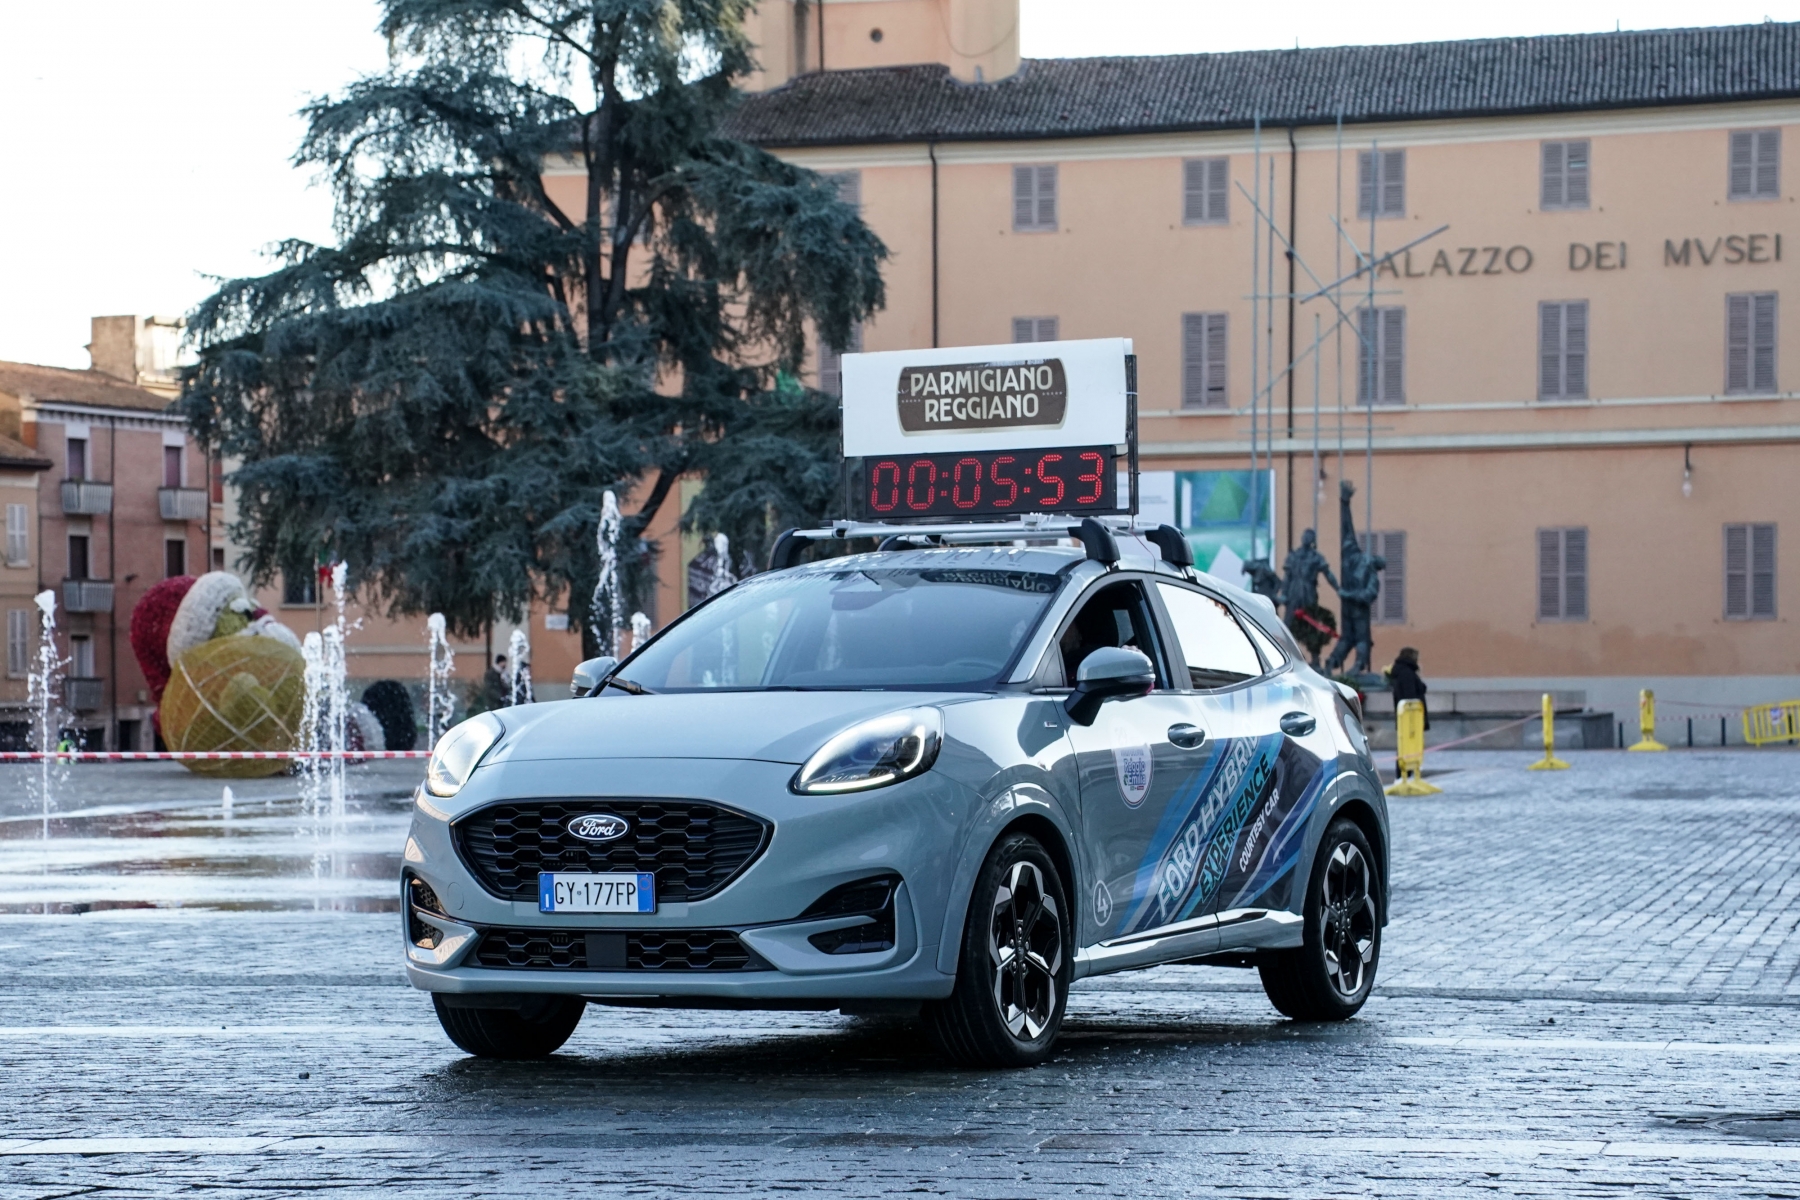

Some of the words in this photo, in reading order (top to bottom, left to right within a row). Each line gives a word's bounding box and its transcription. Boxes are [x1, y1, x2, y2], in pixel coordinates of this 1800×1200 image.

[1568, 241, 1627, 271] DEI
[1663, 233, 1783, 267] MVSEI
[910, 365, 1053, 397] PARMIGIANO
[924, 393, 1039, 423] REGGIANO
[871, 452, 1104, 512] 00:05:53
[579, 818, 616, 836] Ford
[1200, 752, 1271, 901] EXPERIENCE
[1239, 810, 1266, 873] COURTESY
[1264, 787, 1280, 818] CAR
[1156, 823, 1199, 919] FORD
[1097, 888, 1109, 918] 4
